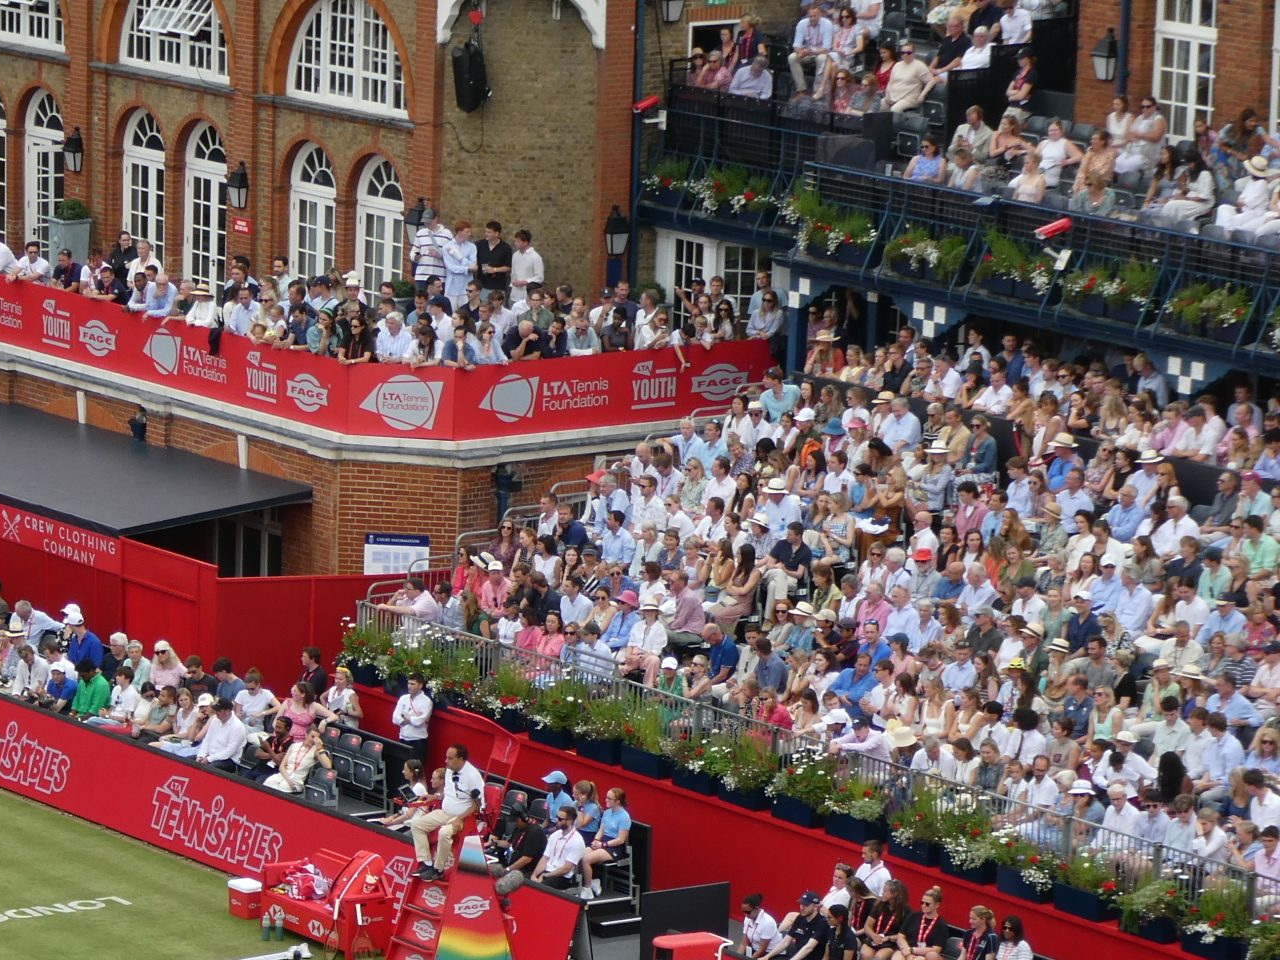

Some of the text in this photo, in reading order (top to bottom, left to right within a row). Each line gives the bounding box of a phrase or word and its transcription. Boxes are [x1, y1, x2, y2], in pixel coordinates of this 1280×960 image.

[0, 298, 23, 315] Tennis
[42, 314, 70, 340] YOUTH
[183, 345, 227, 369] LTA Tennis
[183, 361, 227, 384] Foundation
[246, 367, 277, 395] YOUTH
[382, 392, 429, 403] LTA Tennis
[543, 377, 609, 397] LTA Tennis
[632, 377, 677, 401] YOUTH
[382, 402, 429, 411] Foundation
[542, 394, 609, 412] Foundation
[24, 516, 116, 555] CREW CLOTHING
[43, 538, 96, 566] COMPANY
